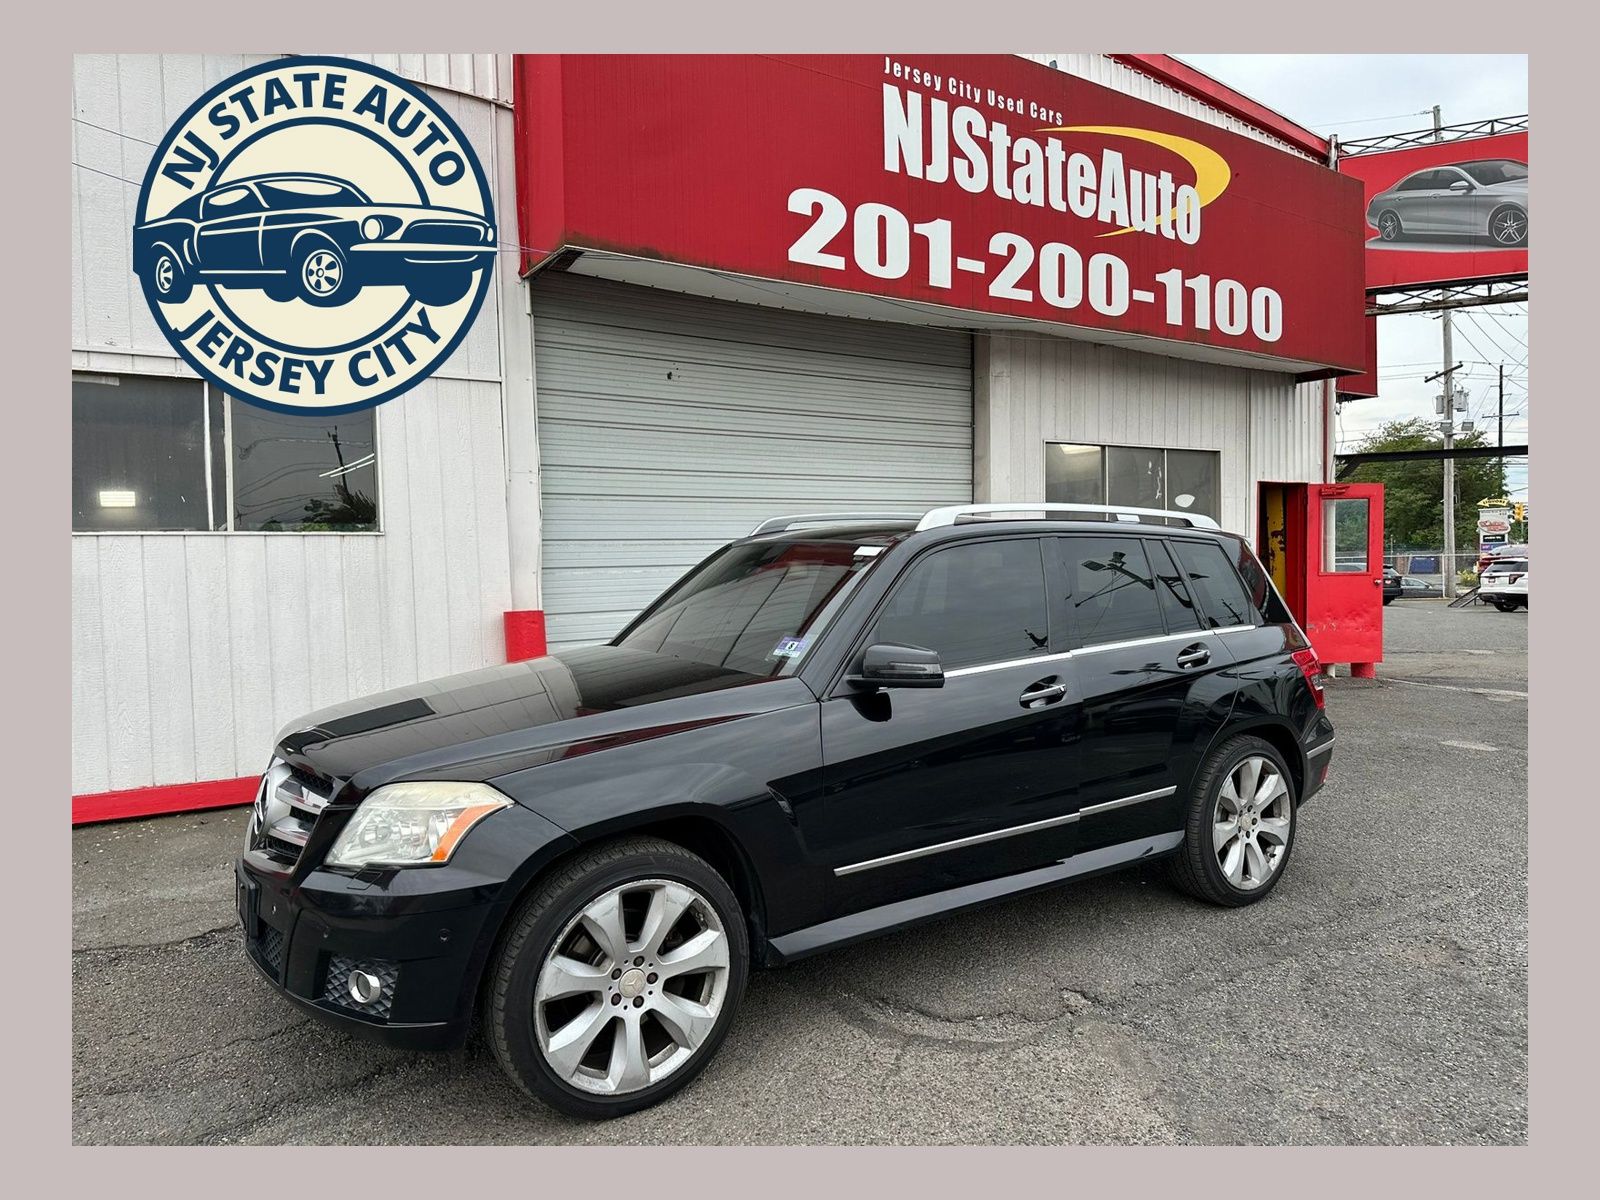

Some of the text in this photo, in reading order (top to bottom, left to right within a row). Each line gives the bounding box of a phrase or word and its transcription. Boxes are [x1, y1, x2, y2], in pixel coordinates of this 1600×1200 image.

[882, 83, 1201, 245] NJStateAuto
[884, 56, 1063, 126] Jersey City Used Cars
[787, 188, 1283, 342] 201-200-1100
